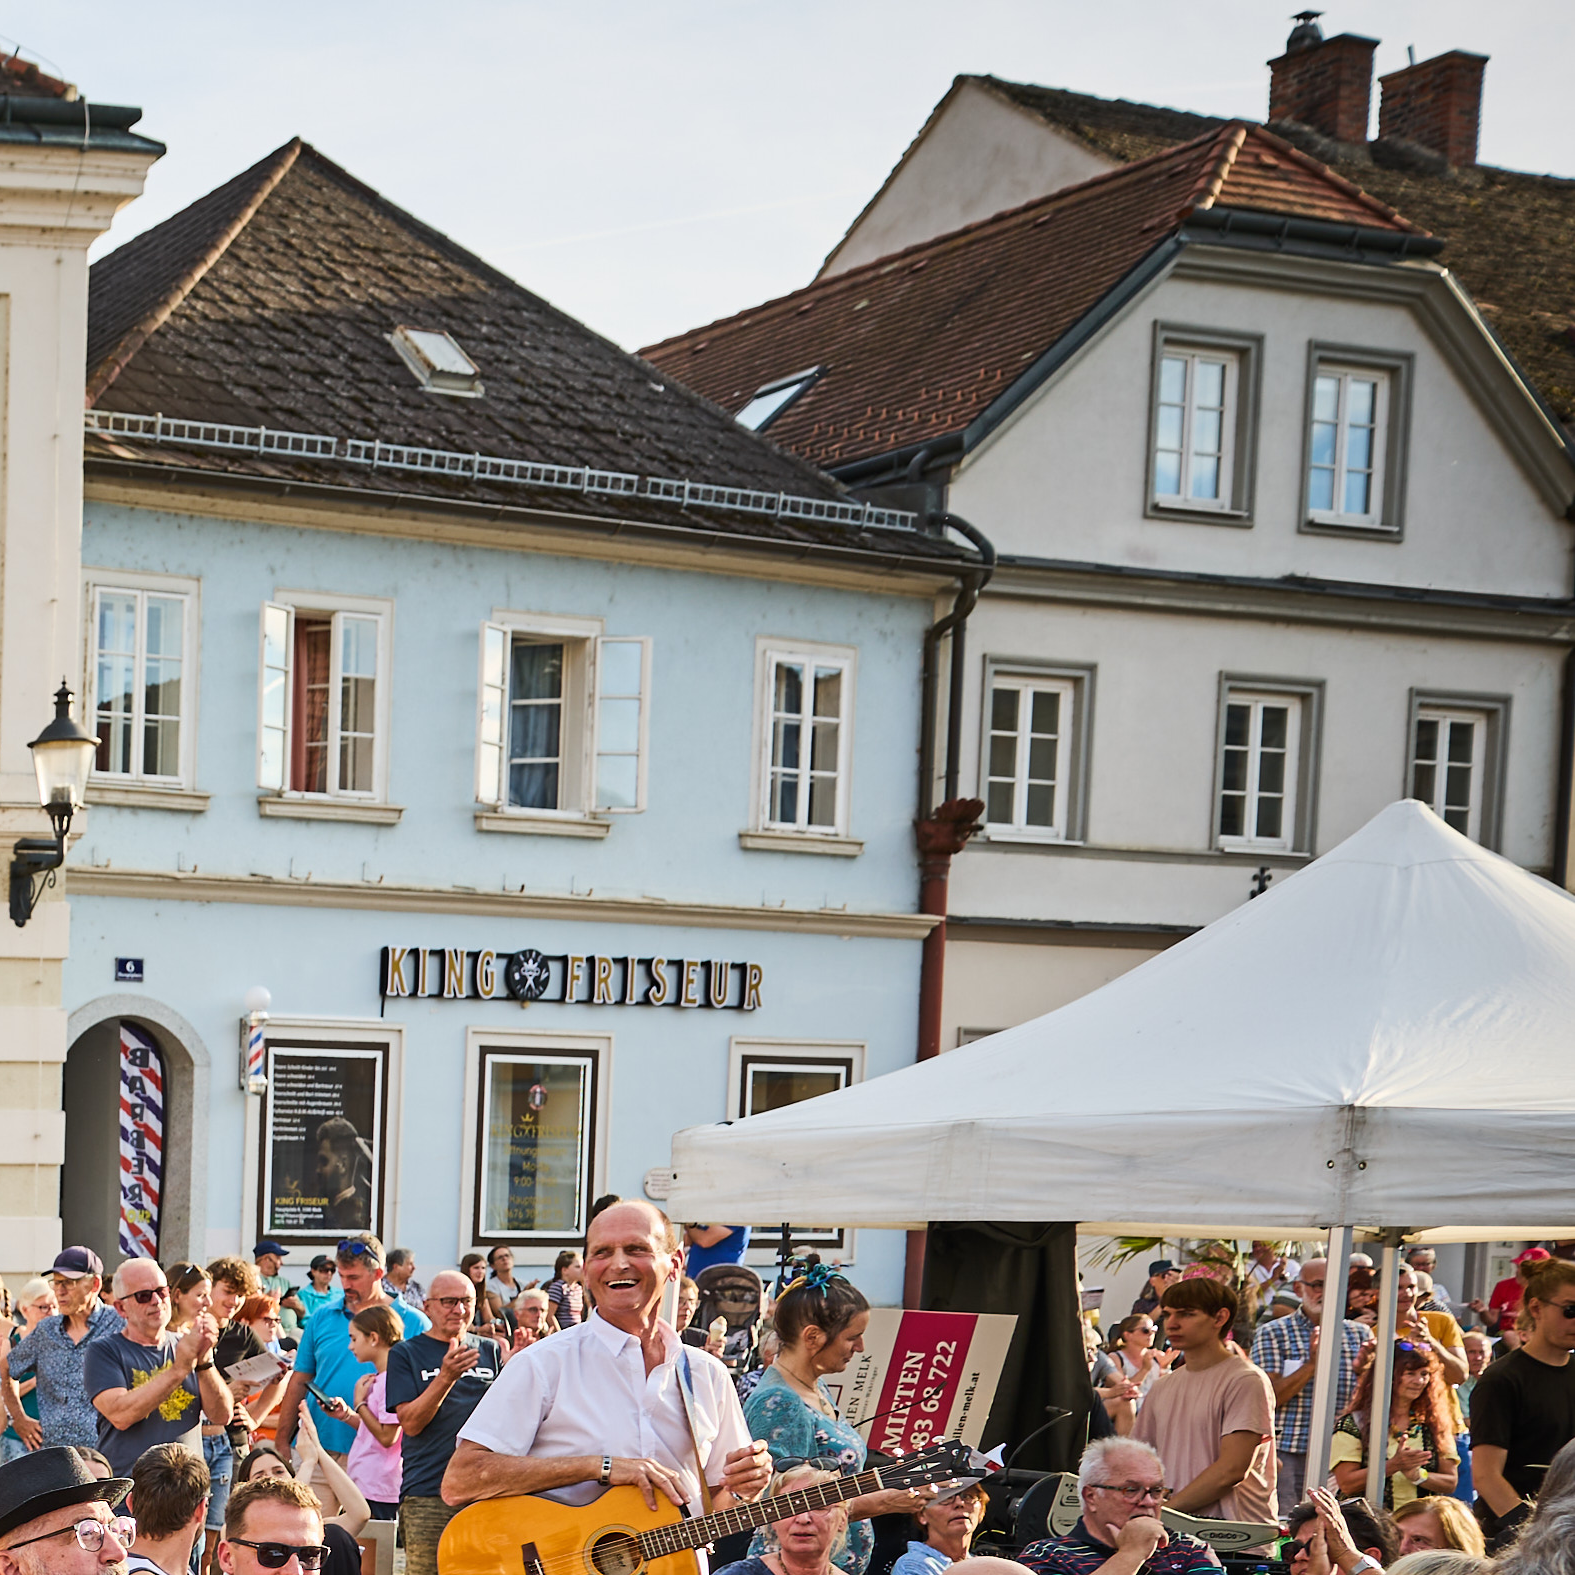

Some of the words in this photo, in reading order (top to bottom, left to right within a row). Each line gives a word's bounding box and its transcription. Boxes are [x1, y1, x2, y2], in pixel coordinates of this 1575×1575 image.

[126, 960, 135, 973] 6
[385, 946, 496, 1000] KING
[565, 954, 763, 1010] FRISEUR
[275, 1197, 294, 1205] KING
[296, 1197, 329, 1206] FRISEUR
[421, 1366, 494, 1381] HAD
[853, 1354, 873, 1392] MELK
[928, 1340, 957, 1381] 722
